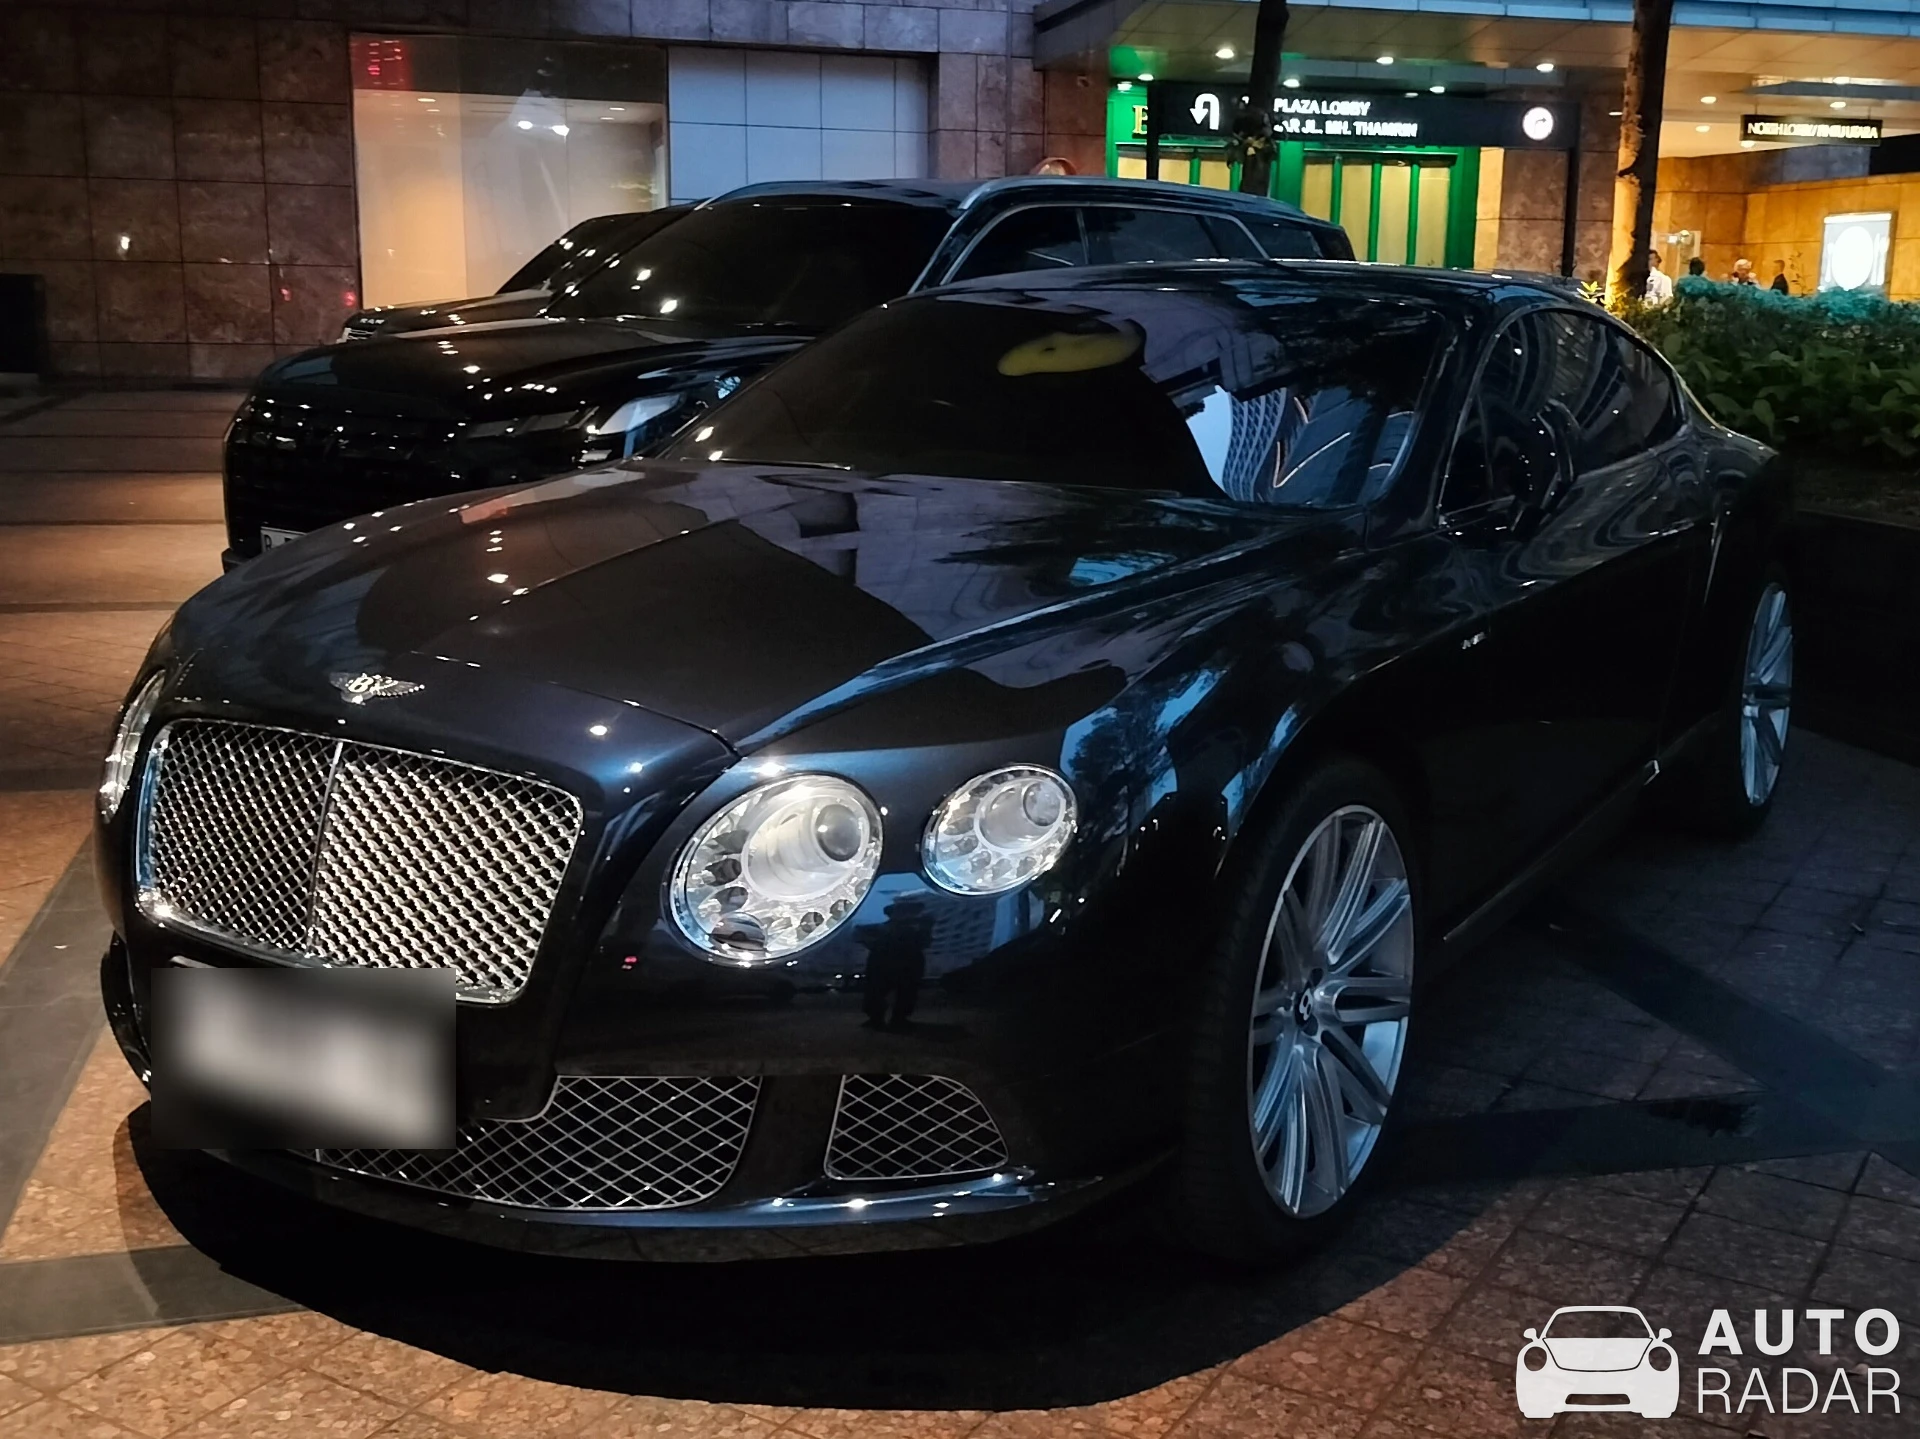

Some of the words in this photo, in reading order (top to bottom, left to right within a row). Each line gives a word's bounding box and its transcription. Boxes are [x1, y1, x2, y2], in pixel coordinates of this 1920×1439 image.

[1273, 97, 1320, 114] PLAZA
[1321, 100, 1371, 116] LOBBY
[1353, 121, 1418, 138] THAMRIN
